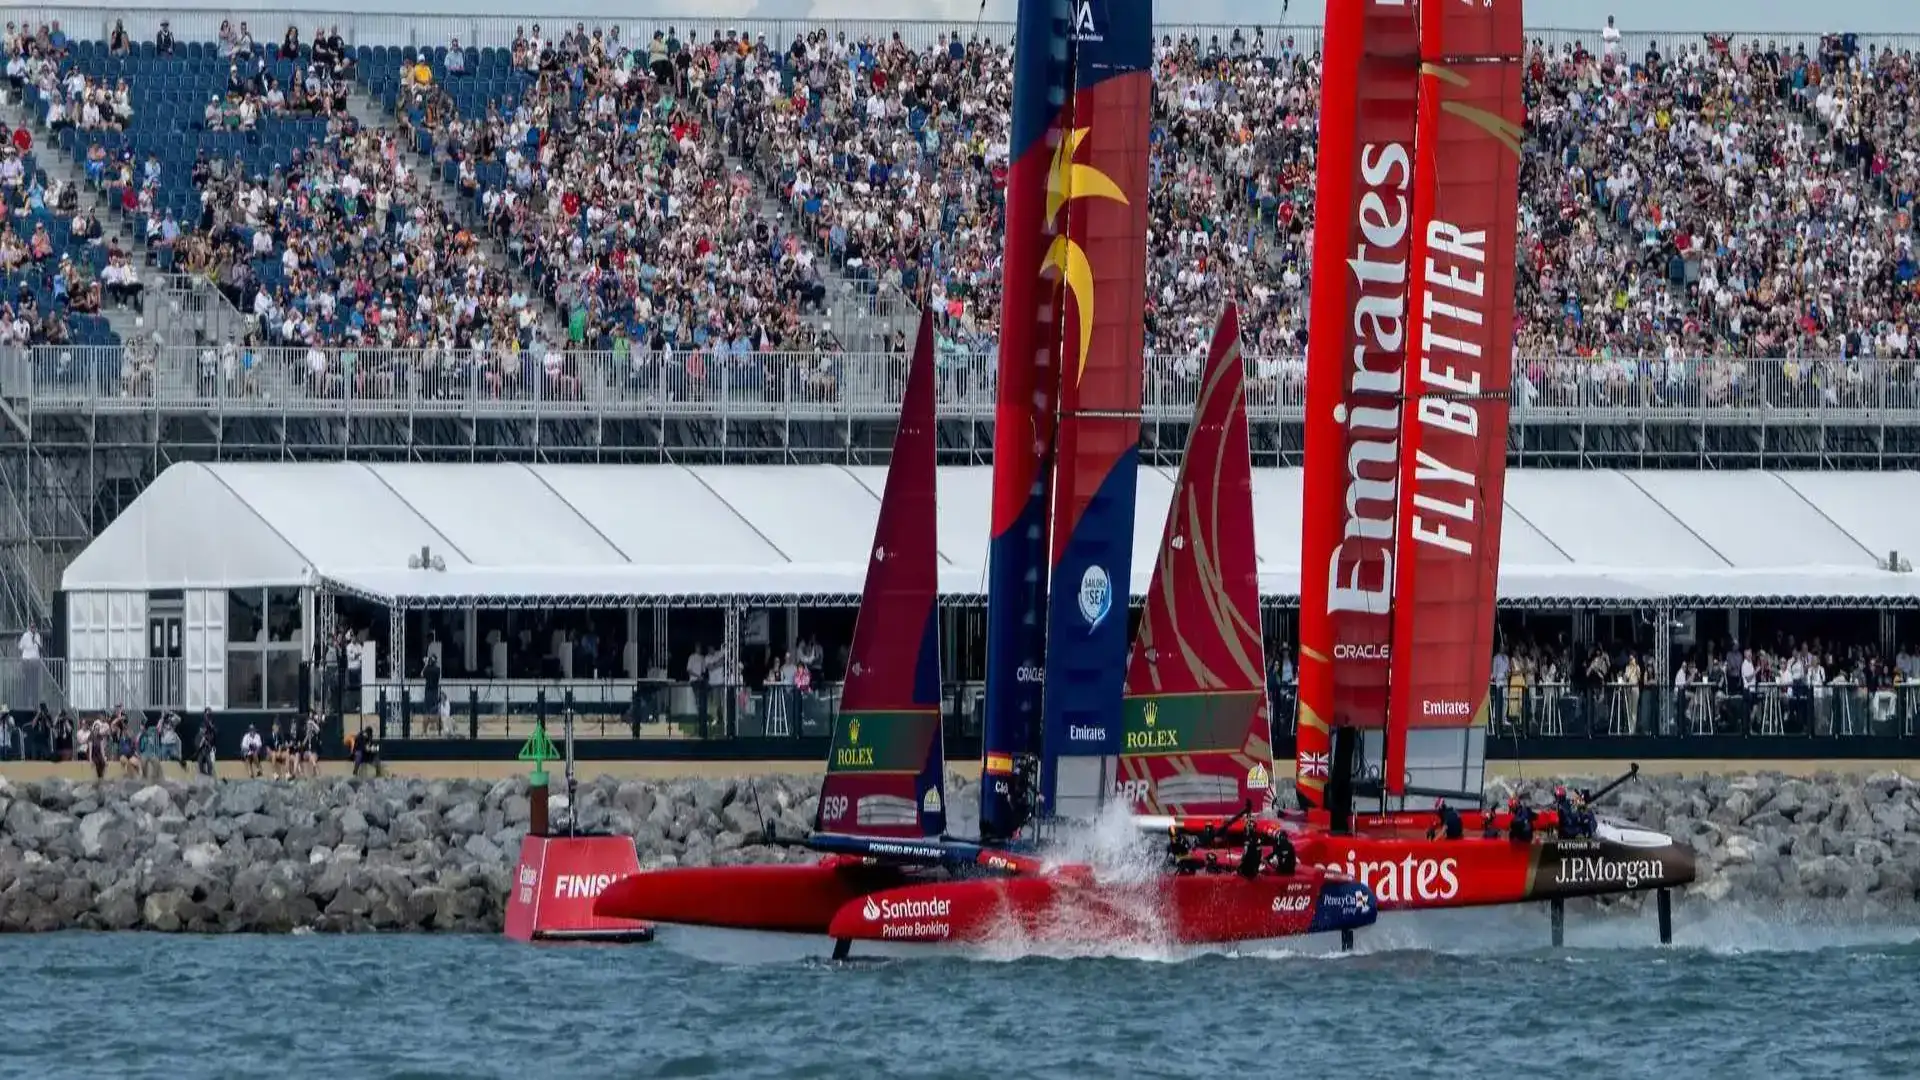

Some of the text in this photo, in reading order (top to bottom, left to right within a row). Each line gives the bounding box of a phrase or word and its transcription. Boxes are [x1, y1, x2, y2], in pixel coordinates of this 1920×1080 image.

[1327, 143, 1410, 615] Emirates
[1412, 220, 1486, 555] FLY BETTER
[1334, 644, 1389, 659] ORACLE
[1016, 666, 1044, 682] ORACLE
[1423, 698, 1470, 715] Emirates
[1070, 724, 1106, 741] Emirates
[1127, 730, 1178, 748] ROLEX
[837, 748, 873, 765] ROLEX
[823, 796, 848, 820] ESP
[555, 873, 628, 898] FINIS
[881, 896, 951, 919] Santander
[882, 920, 950, 937] Private Banking
